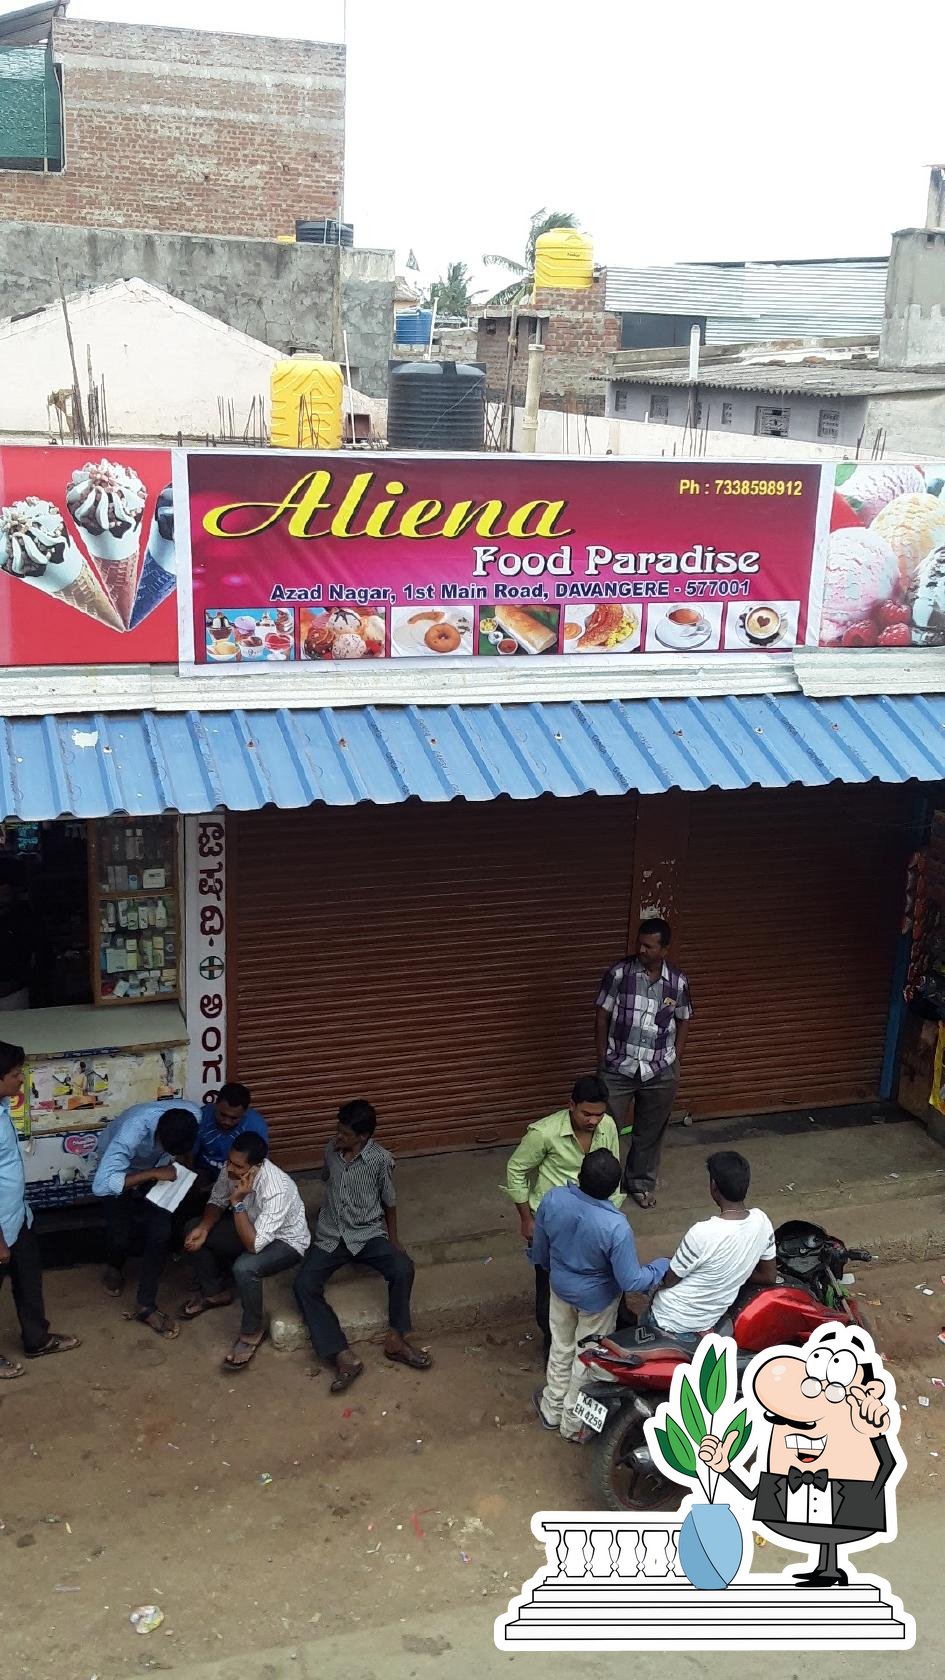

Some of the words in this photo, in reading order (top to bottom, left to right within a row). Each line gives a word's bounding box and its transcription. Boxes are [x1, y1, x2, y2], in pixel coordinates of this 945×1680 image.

[679, 479, 700, 495] Ph
[714, 479, 803, 497] 7338598912
[202, 470, 573, 539] Aliena
[472, 545, 573, 577] Food
[585, 544, 761, 577] Paradise
[270, 584, 322, 602] Azad
[328, 583, 396, 604] Nagar,
[402, 583, 434, 601] 1st
[440, 583, 488, 600] Main
[494, 582, 549, 601] Road,
[555, 581, 669, 598] DAVANGERE
[685, 579, 750, 597] 577001
[582, 1396, 592, 1408] KA
